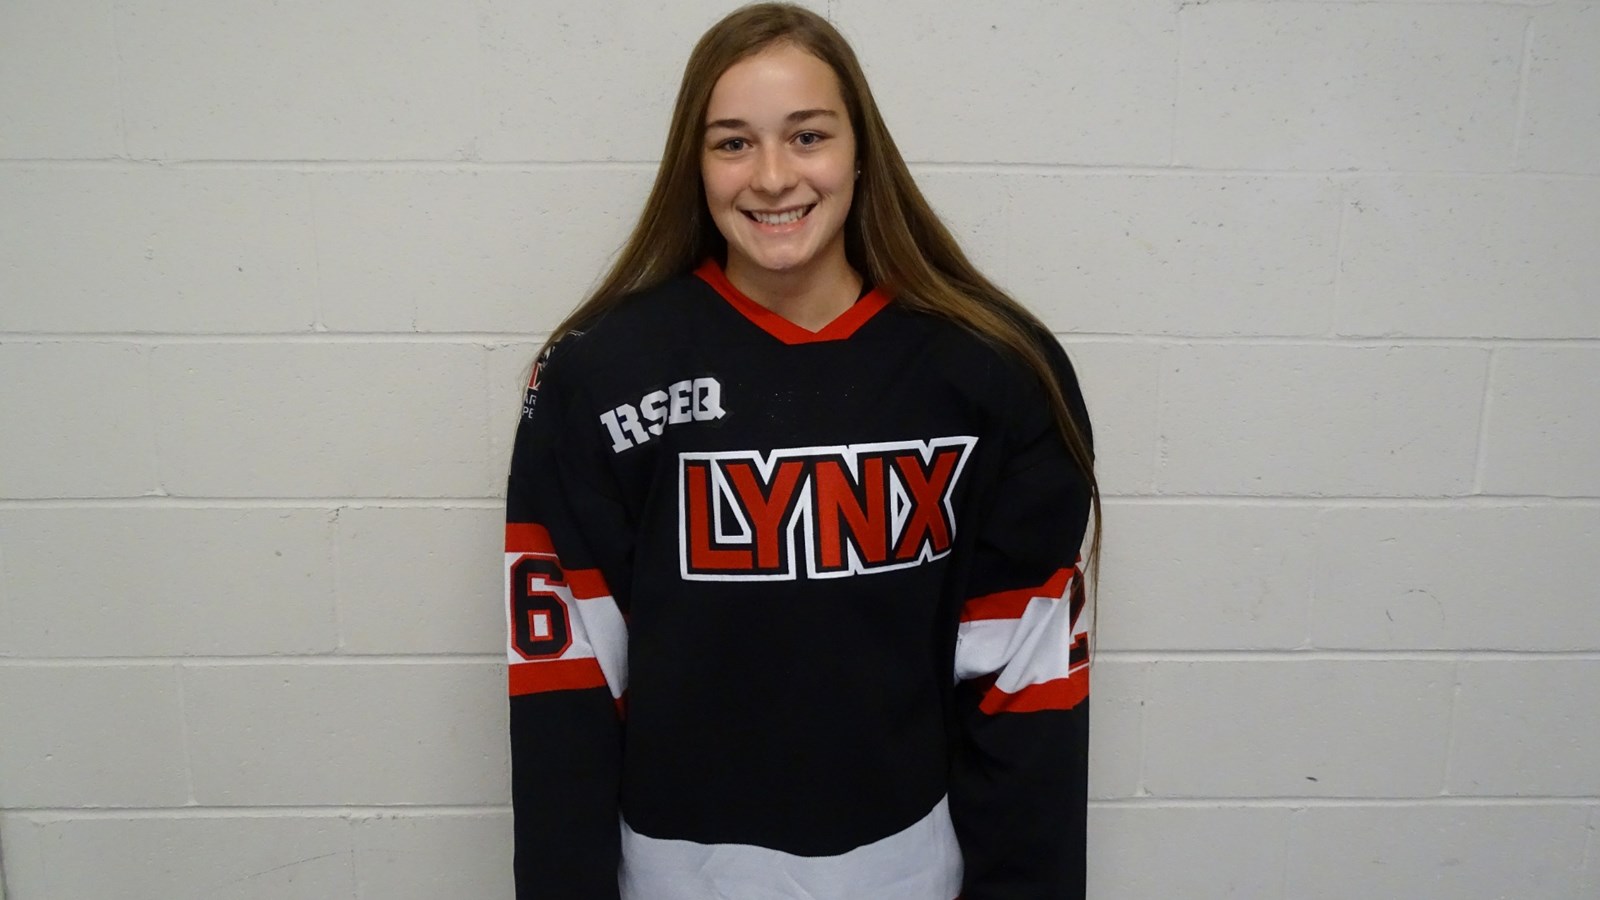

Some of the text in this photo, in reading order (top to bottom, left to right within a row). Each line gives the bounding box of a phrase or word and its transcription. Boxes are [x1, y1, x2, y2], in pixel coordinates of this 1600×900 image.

[600, 377, 726, 453] RSEQ
[679, 436, 978, 581] LYNX
[510, 554, 573, 660] 6
